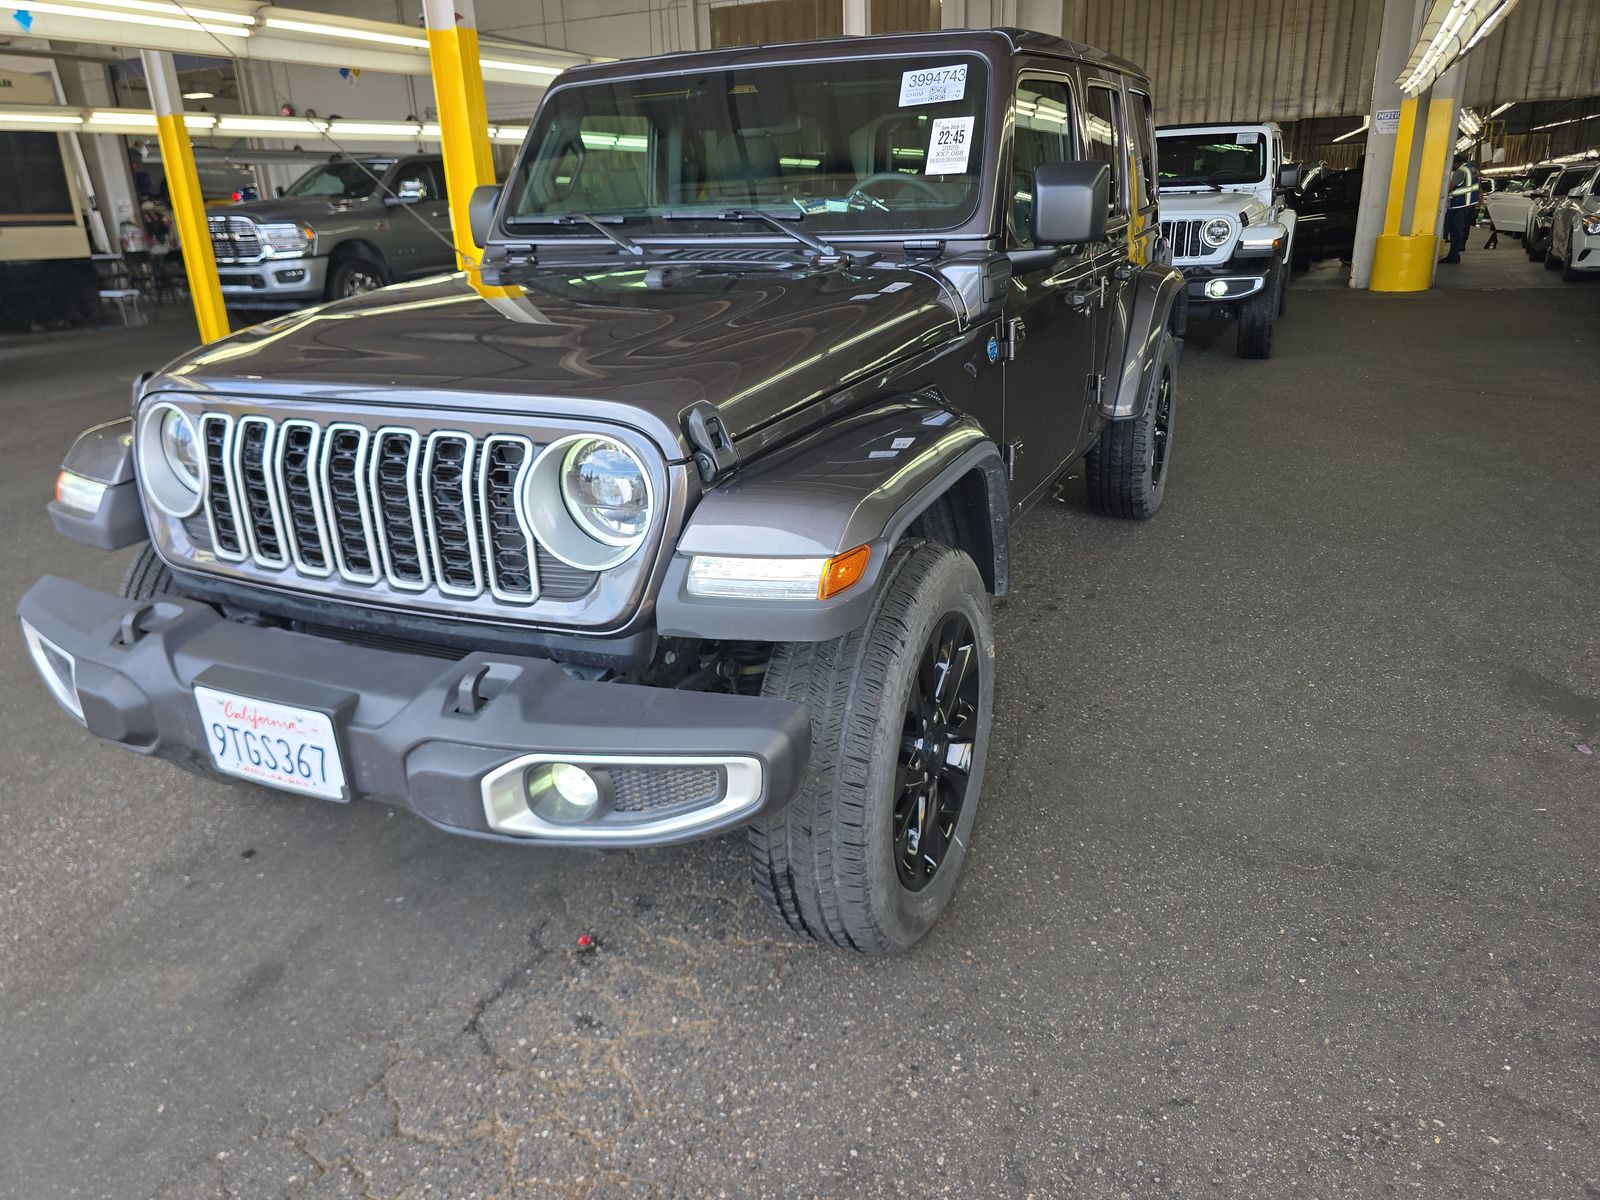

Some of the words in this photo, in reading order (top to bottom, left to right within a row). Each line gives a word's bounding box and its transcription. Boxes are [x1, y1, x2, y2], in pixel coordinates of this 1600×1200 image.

[909, 68, 966, 88] 3994743
[1377, 111, 1401, 120] NOTIC
[938, 129, 965, 145] 22:45
[223, 701, 305, 734] California
[212, 722, 326, 783] 9TGS367
